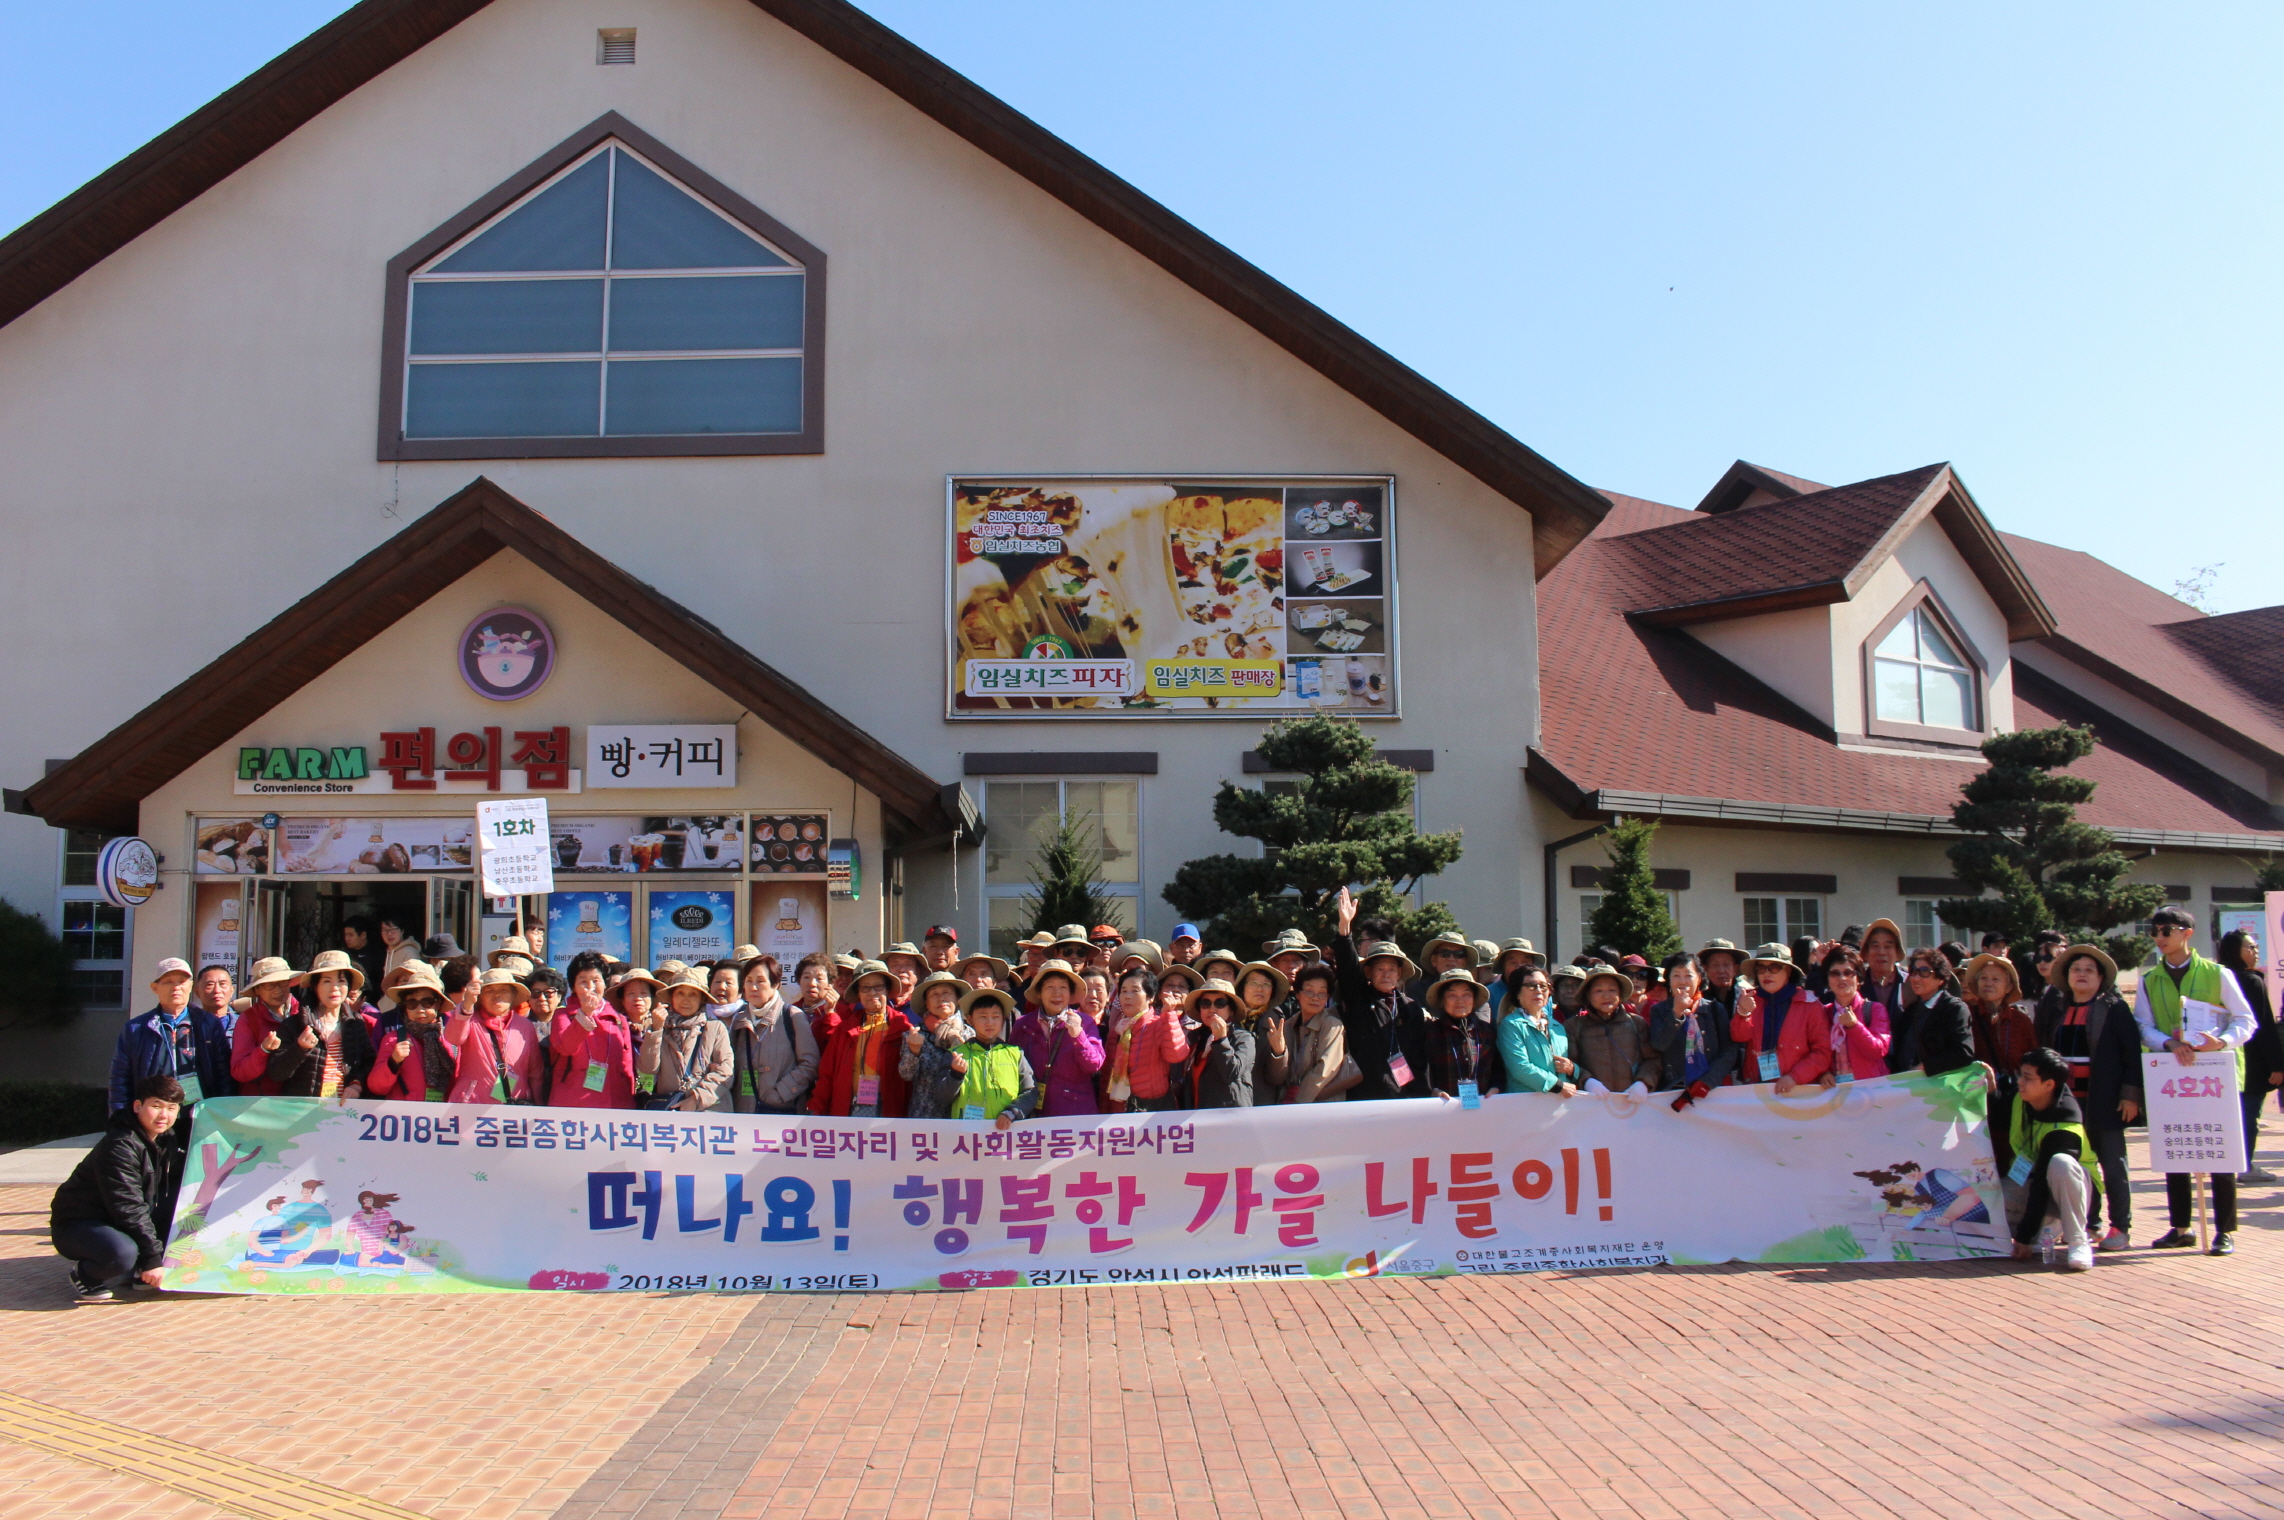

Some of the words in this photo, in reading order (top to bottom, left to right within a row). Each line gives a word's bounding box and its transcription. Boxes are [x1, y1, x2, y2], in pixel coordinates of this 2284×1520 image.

[988, 511, 1046, 521] SINCE1967
[973, 525, 1015, 536] 대한민국
[1020, 524, 1062, 535] 최초치즈
[985, 540, 1060, 552] 임실치즈농협
[1031, 635, 1046, 645] SINCE
[1049, 635, 1062, 645] 1967
[978, 667, 1125, 688] 임실치즈피자
[1153, 666, 1226, 687] 임실치즈
[1231, 670, 1275, 687] 판매장
[238, 746, 370, 781] FARM
[378, 726, 570, 791] 편의점
[253, 783, 322, 793] Convenience
[324, 783, 353, 793] Store
[493, 818, 536, 837] 1호차
[662, 936, 721, 949] 일레디젤라또
[783, 952, 797, 960] 생각
[2160, 1076, 2225, 1099] 4호차
[2163, 1123, 2223, 1134] 봉래초등학교
[358, 1113, 460, 1146] 2018년
[474, 1116, 738, 1155] 중림종합사회복지관
[752, 1128, 897, 1161] 노인일자리
[911, 1132, 939, 1162] 및
[952, 1123, 1195, 1161] 사회활동지원사업
[2164, 1136, 2225, 1147] 숭의초등학교
[2165, 1150, 2226, 1160] 청구초등학교
[587, 1170, 852, 1252] 떠나요!
[892, 1171, 1146, 1256] 행복한
[1184, 1163, 1326, 1247] 가을
[1364, 1147, 1614, 1240] 나들이!
[617, 1274, 707, 1290] 2018년
[716, 1274, 773, 1290] 10월
[1029, 1268, 1102, 1287] 경기도
